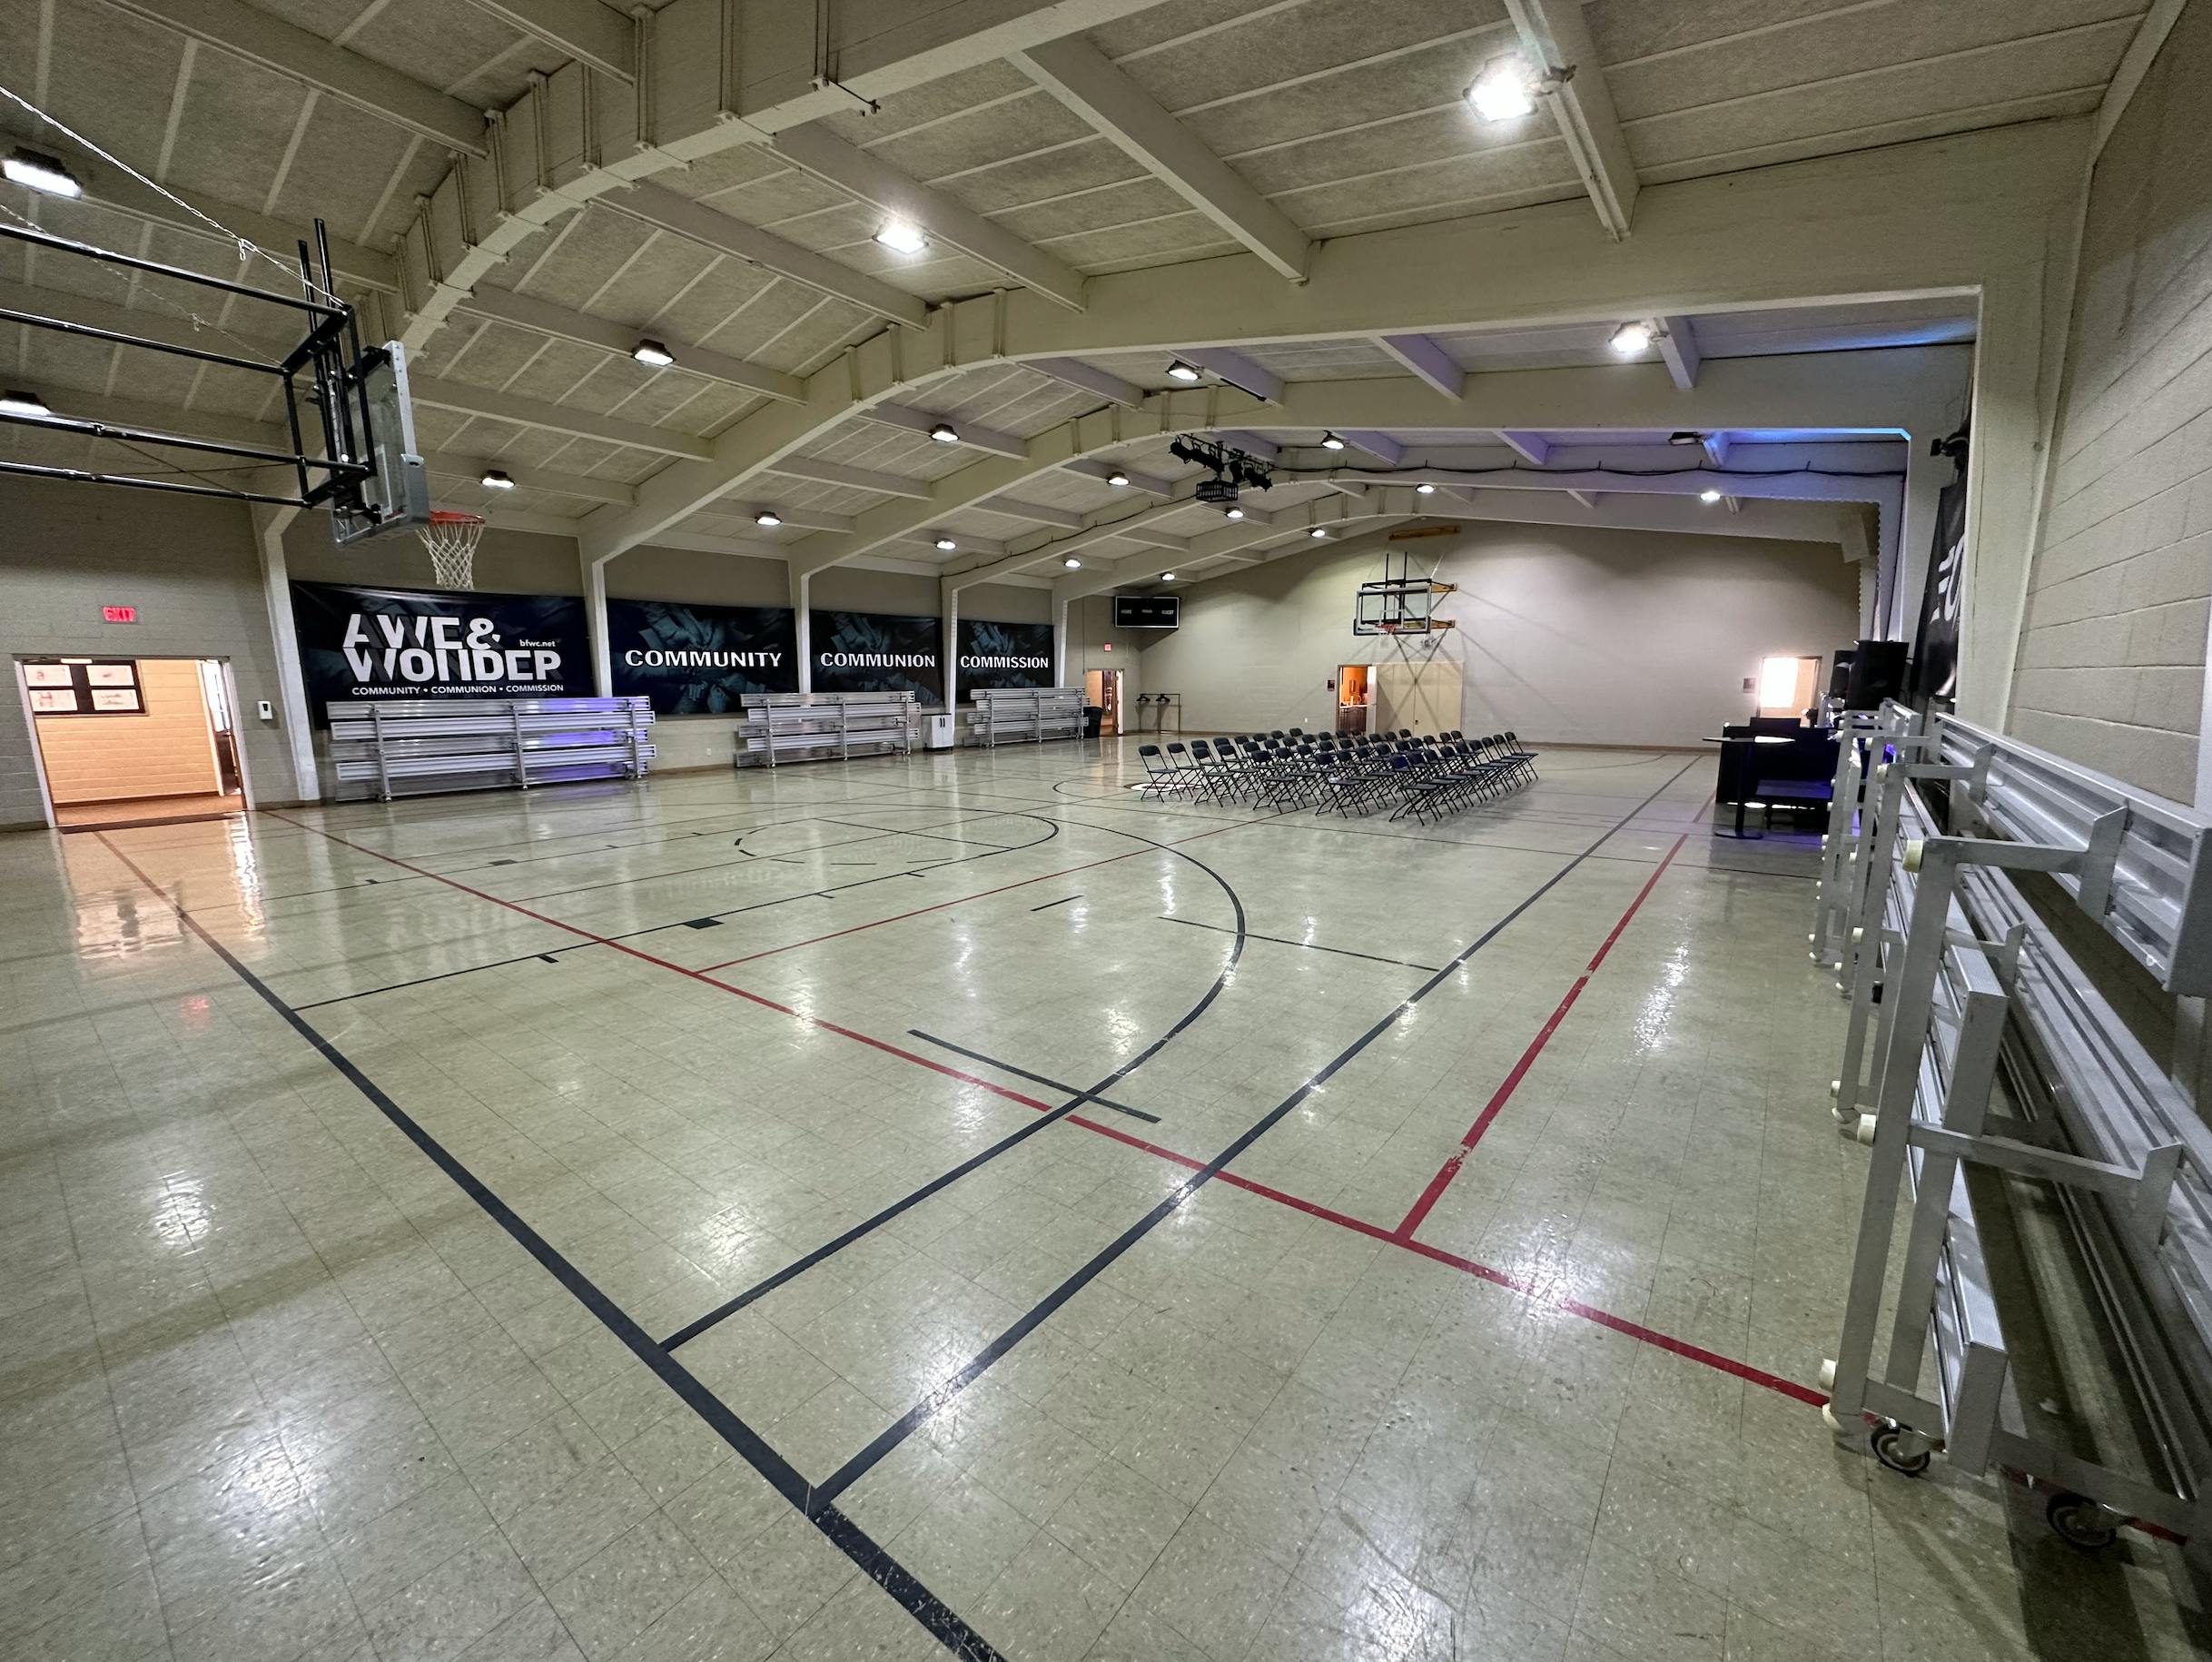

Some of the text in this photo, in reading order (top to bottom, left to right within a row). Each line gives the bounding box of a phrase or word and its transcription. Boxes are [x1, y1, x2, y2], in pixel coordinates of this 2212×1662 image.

[519, 639, 556, 648] bfwc.net
[342, 648, 562, 682] WONDER
[625, 649, 782, 668] COMMUNITY
[820, 652, 935, 668] COMMUNION
[960, 655, 1049, 669] COMMISSION
[351, 685, 564, 696] COMMUNITY COMMUNION COMMISSION
